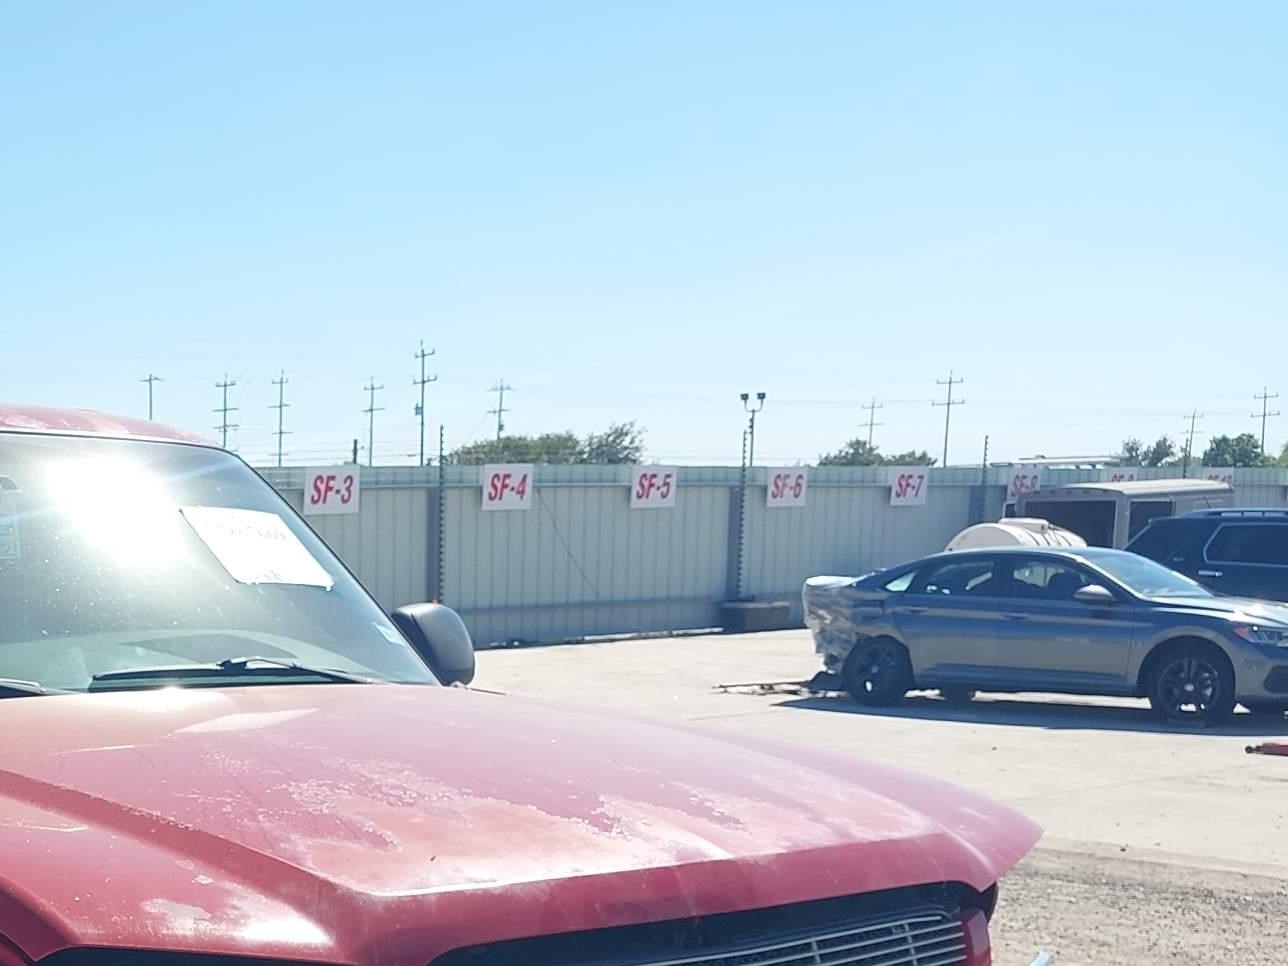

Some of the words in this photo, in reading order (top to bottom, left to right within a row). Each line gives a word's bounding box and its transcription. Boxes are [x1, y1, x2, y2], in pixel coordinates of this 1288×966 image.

[310, 474, 354, 505] SF-3
[487, 472, 528, 501] SF-4
[635, 472, 672, 500] SF-5
[770, 473, 804, 499] SF-6
[894, 473, 924, 498] SF-7
